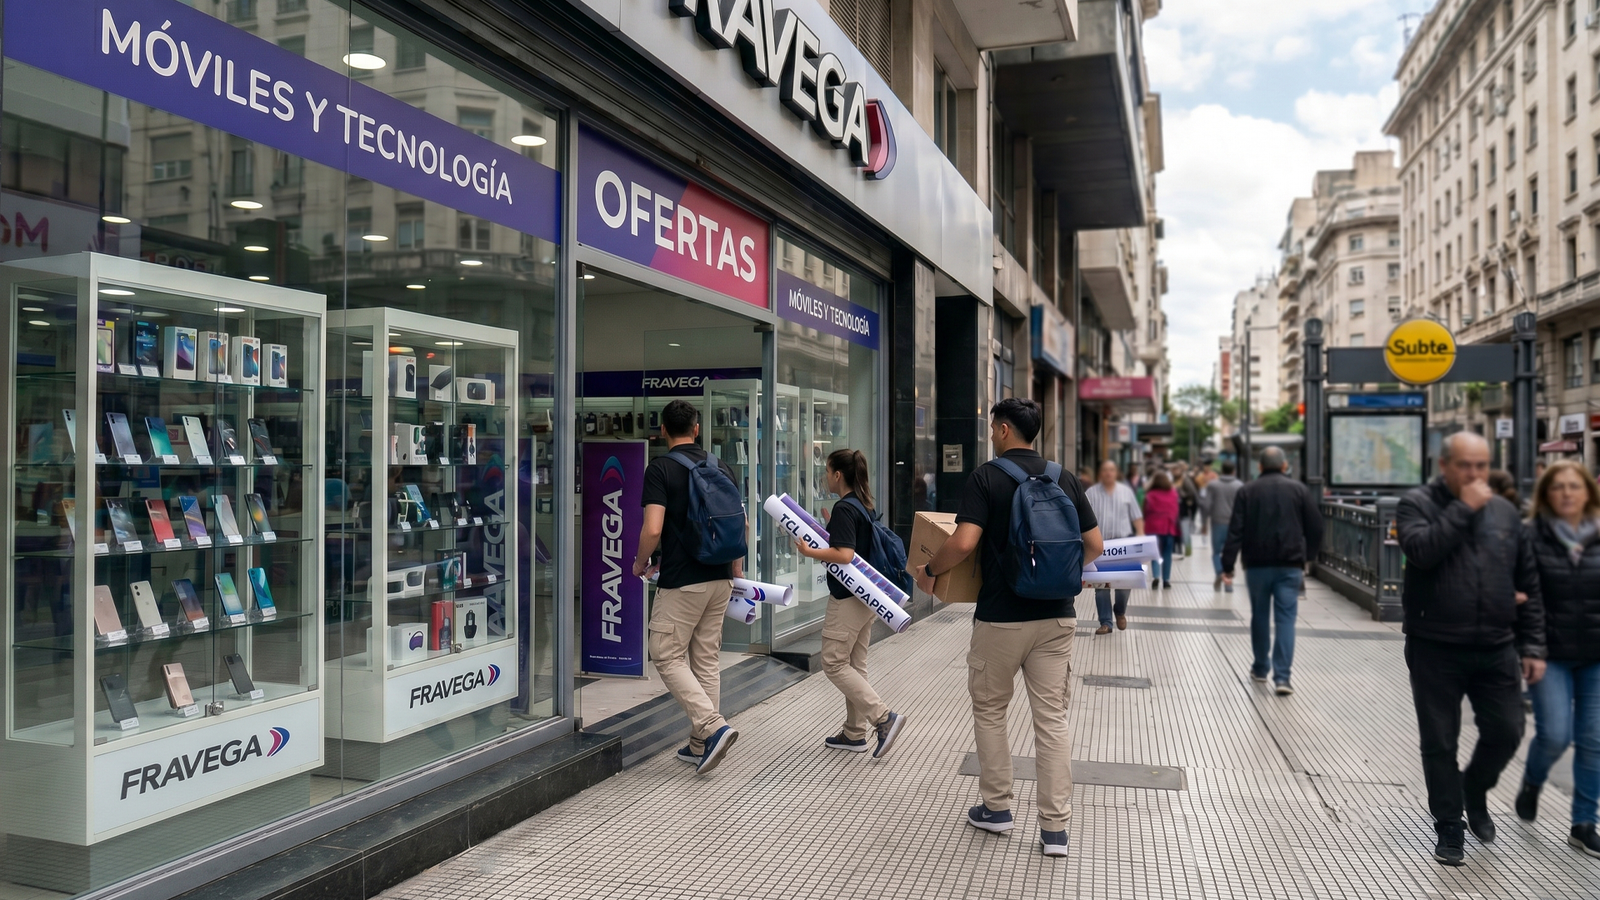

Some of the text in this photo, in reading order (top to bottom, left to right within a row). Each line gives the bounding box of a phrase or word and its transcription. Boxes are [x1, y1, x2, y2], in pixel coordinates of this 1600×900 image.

[102, 8, 513, 205] MÓVILES Y TECNOLOGÍA
[668, 0, 869, 167] AVEGA
[594, 170, 756, 283] OFERTAS
[788, 288, 870, 337] MÓVILES Y TECNOLOGÍA
[1391, 338, 1448, 356] Subte
[602, 489, 623, 643] FRAVEGA
[780, 513, 800, 537] TCL
[854, 585, 894, 623] PAPER
[409, 668, 485, 709] FRAVEGA
[120, 734, 263, 800] FRAVEGA
